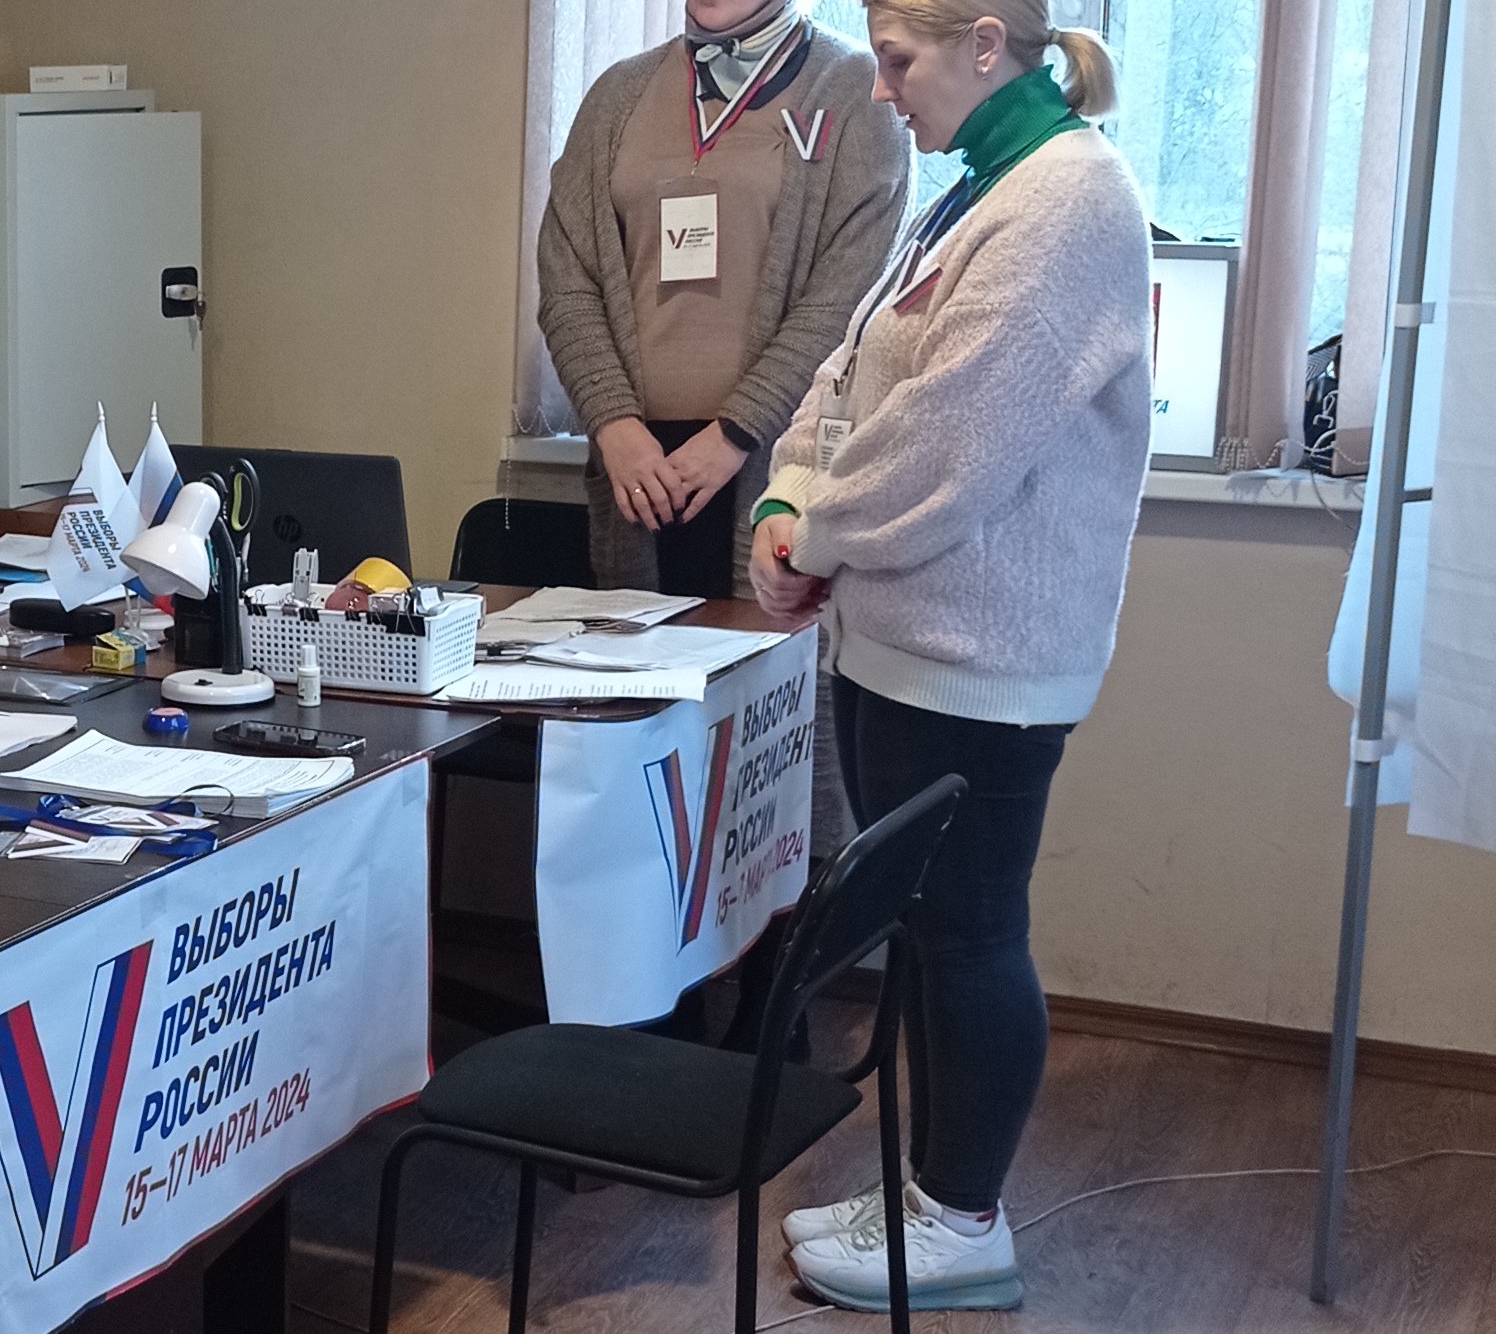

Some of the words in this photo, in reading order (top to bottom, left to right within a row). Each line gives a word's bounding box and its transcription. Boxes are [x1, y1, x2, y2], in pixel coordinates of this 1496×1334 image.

[67, 511, 93, 549] РОССИИ
[79, 511, 117, 570] ПРЕЗИДЕНТА
[92, 509, 122, 551] ВЫБОРЫ
[742, 671, 806, 747] ВЫБОРЫ
[167, 867, 300, 985] ВЫБОРЫ
[152, 919, 336, 1069] ПРЕЗИДЕНТА
[134, 1029, 260, 1154] РОССИИ
[188, 1098, 259, 1186] МАРТА
[260, 1067, 311, 1138] 2024
